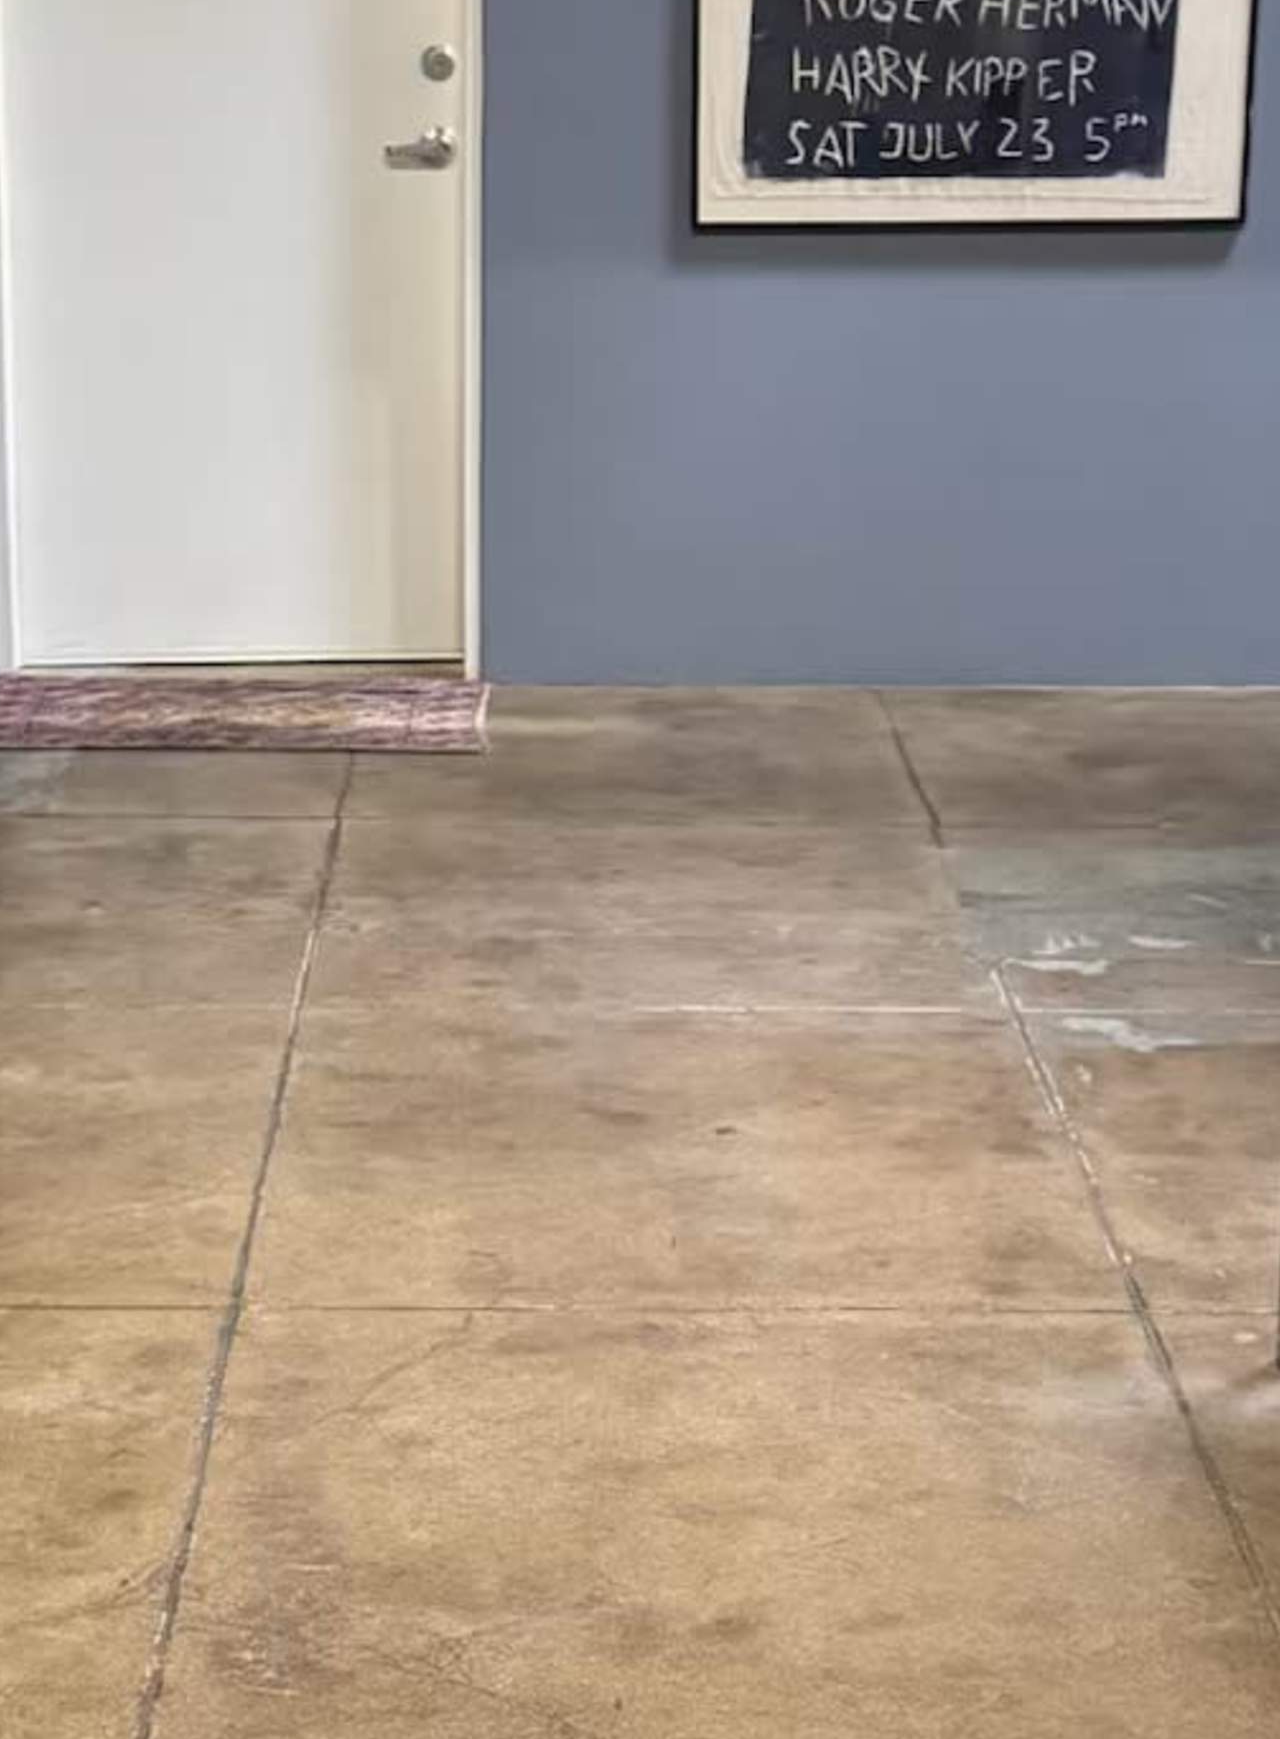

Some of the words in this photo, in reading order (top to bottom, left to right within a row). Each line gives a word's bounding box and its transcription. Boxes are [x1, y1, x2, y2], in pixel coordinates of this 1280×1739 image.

[792, 45, 932, 102] HARRY
[944, 48, 1097, 107] KIPPER
[785, 119, 868, 168] SAT
[878, 118, 980, 162] JULY
[996, 116, 1055, 162] 23
